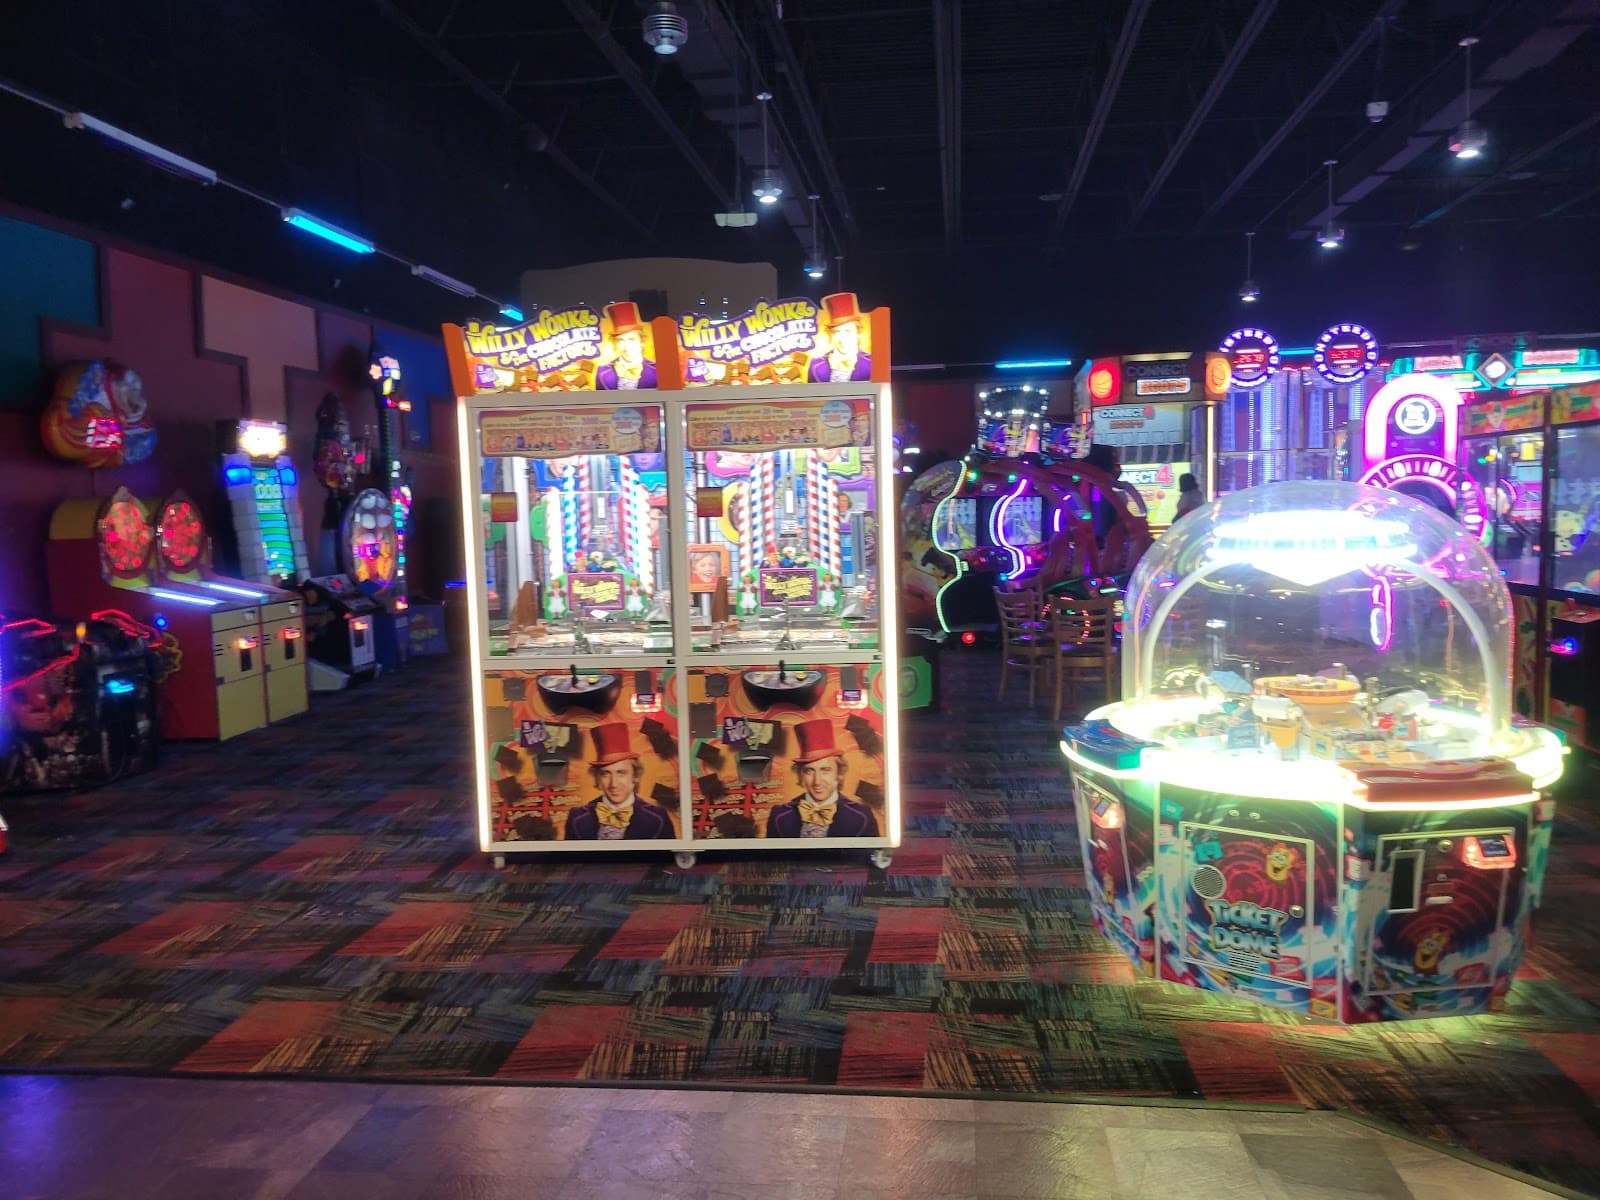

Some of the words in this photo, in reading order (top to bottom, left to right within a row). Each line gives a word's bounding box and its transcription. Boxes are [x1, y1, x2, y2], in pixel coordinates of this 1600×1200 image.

[466, 323, 527, 354] WILLY
[528, 309, 598, 342] WONKA
[681, 317, 742, 348] WILLY
[743, 301, 815, 335] WONKA
[1208, 900, 1286, 932] TICKET
[1213, 926, 1280, 960] DOME
